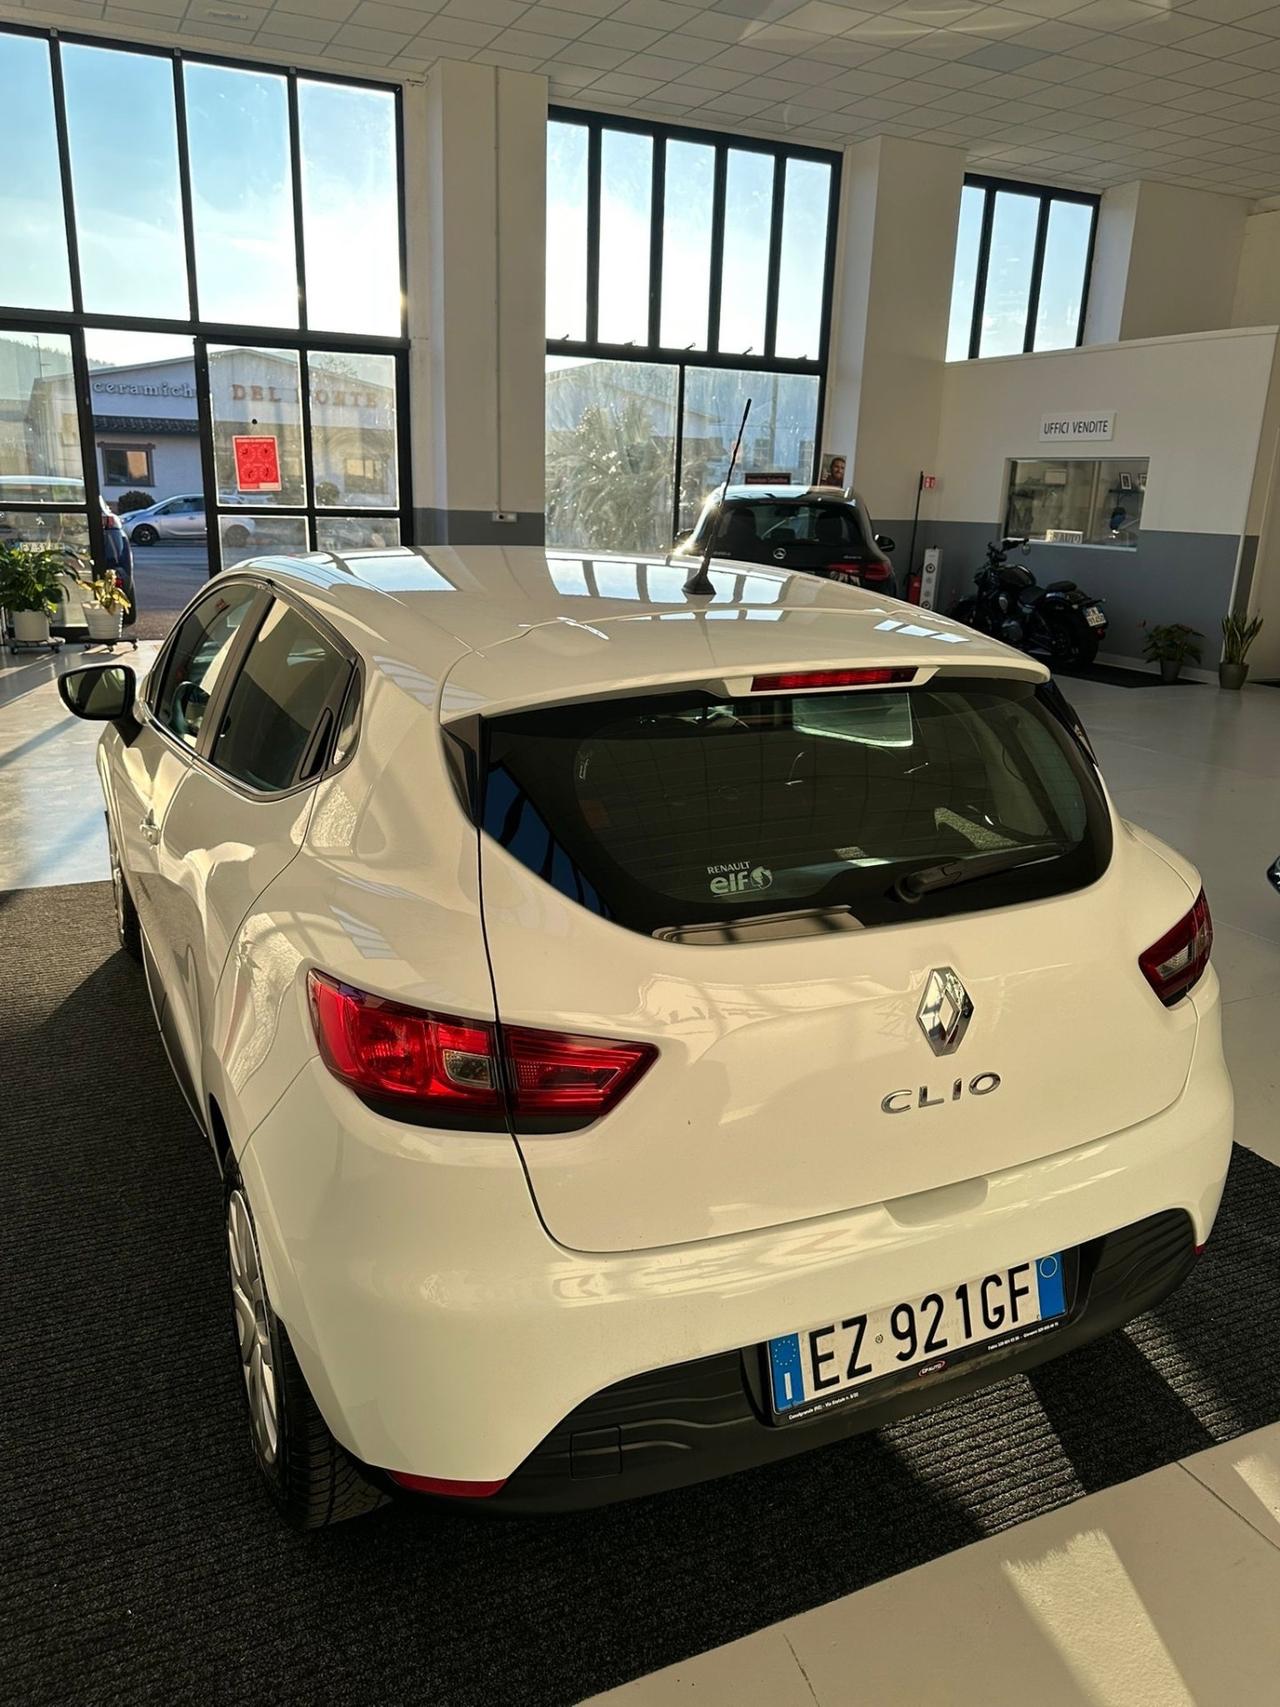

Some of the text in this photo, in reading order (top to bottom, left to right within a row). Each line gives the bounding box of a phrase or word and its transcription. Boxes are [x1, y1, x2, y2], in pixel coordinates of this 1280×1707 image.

[93, 382, 376, 407] ceramich DEL ONTE
[1043, 420, 1109, 434] UFFICI VENDITE
[707, 861, 750, 875] RENAULT
[710, 871, 748, 894] elf
[880, 1072, 1001, 1114] CLIO
[808, 1314, 872, 1391] EZ
